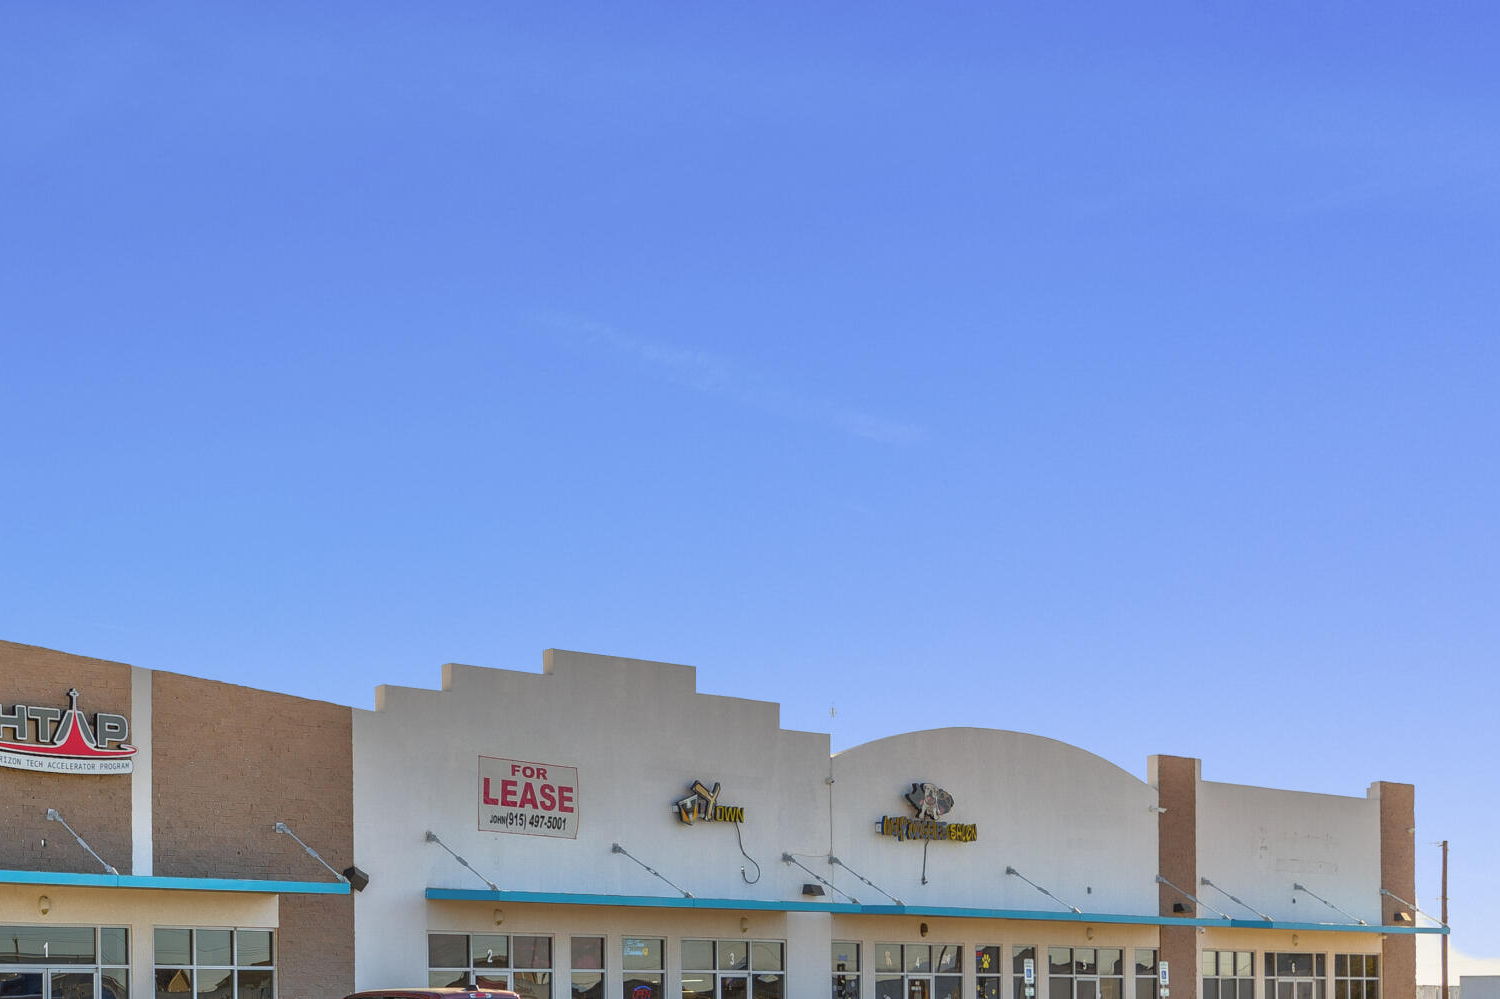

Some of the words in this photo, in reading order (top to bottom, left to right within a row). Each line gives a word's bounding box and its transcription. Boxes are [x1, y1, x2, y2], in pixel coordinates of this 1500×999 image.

[26, 759, 44, 768] TECH
[47, 761, 96, 771] ACCELERATOR
[99, 762, 130, 770] PROGRAM
[511, 764, 548, 780] FOR
[483, 777, 574, 813] LEASE
[529, 814, 567, 831] 497-5001
[43, 942, 49, 958] 1
[487, 949, 493, 962] 2
[730, 953, 735, 965] 3
